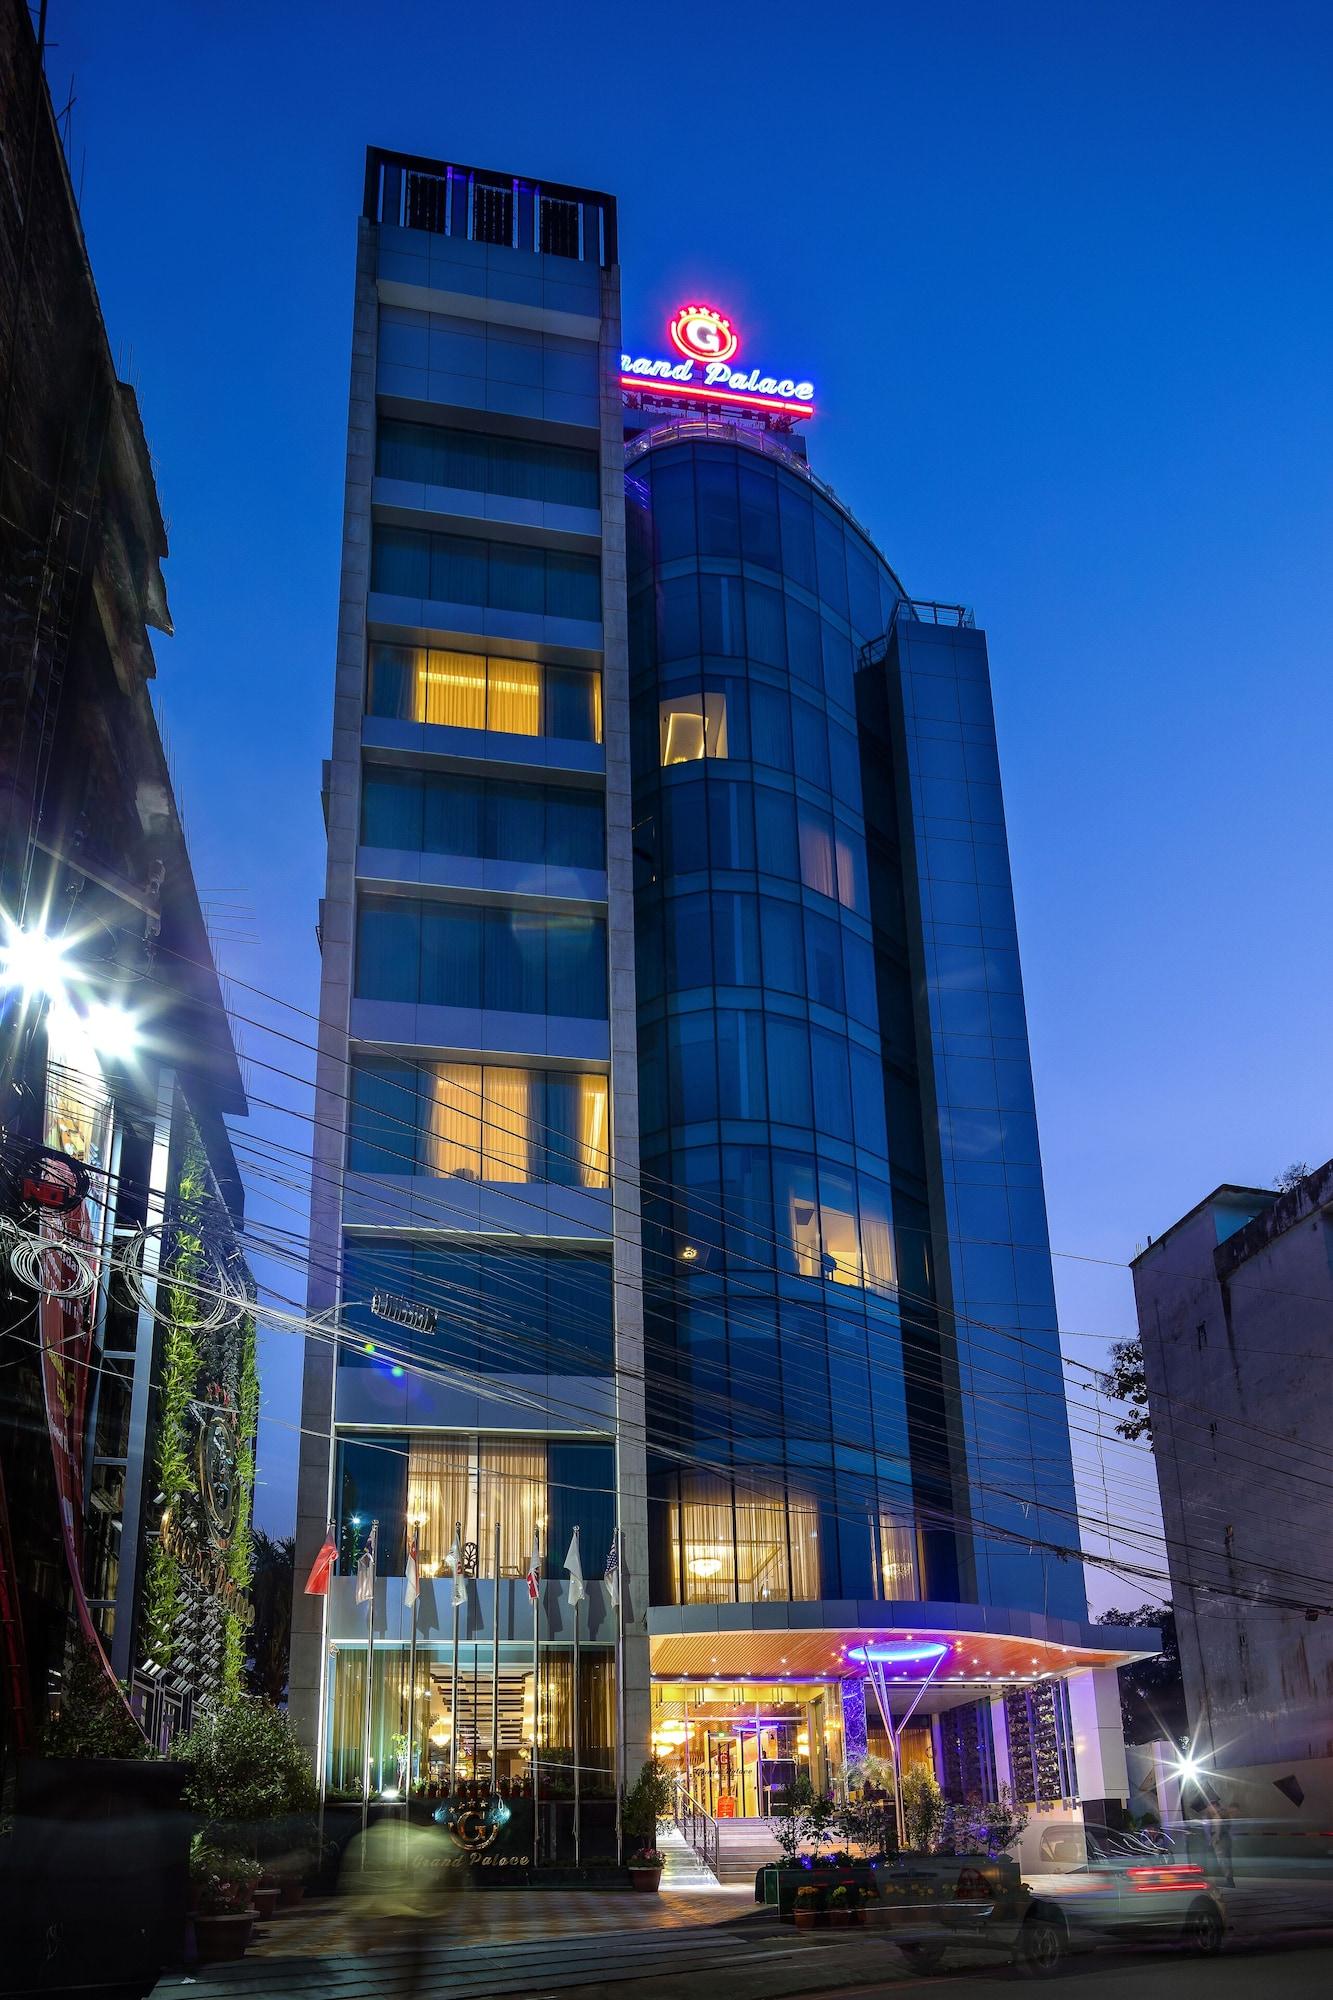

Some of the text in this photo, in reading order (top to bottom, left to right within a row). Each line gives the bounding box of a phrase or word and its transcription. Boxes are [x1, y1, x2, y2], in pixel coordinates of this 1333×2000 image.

[685, 318, 720, 353] G
[621, 354, 814, 400] rand Palace
[457, 1810, 487, 1842] G
[470, 1852, 529, 1866] Palace
